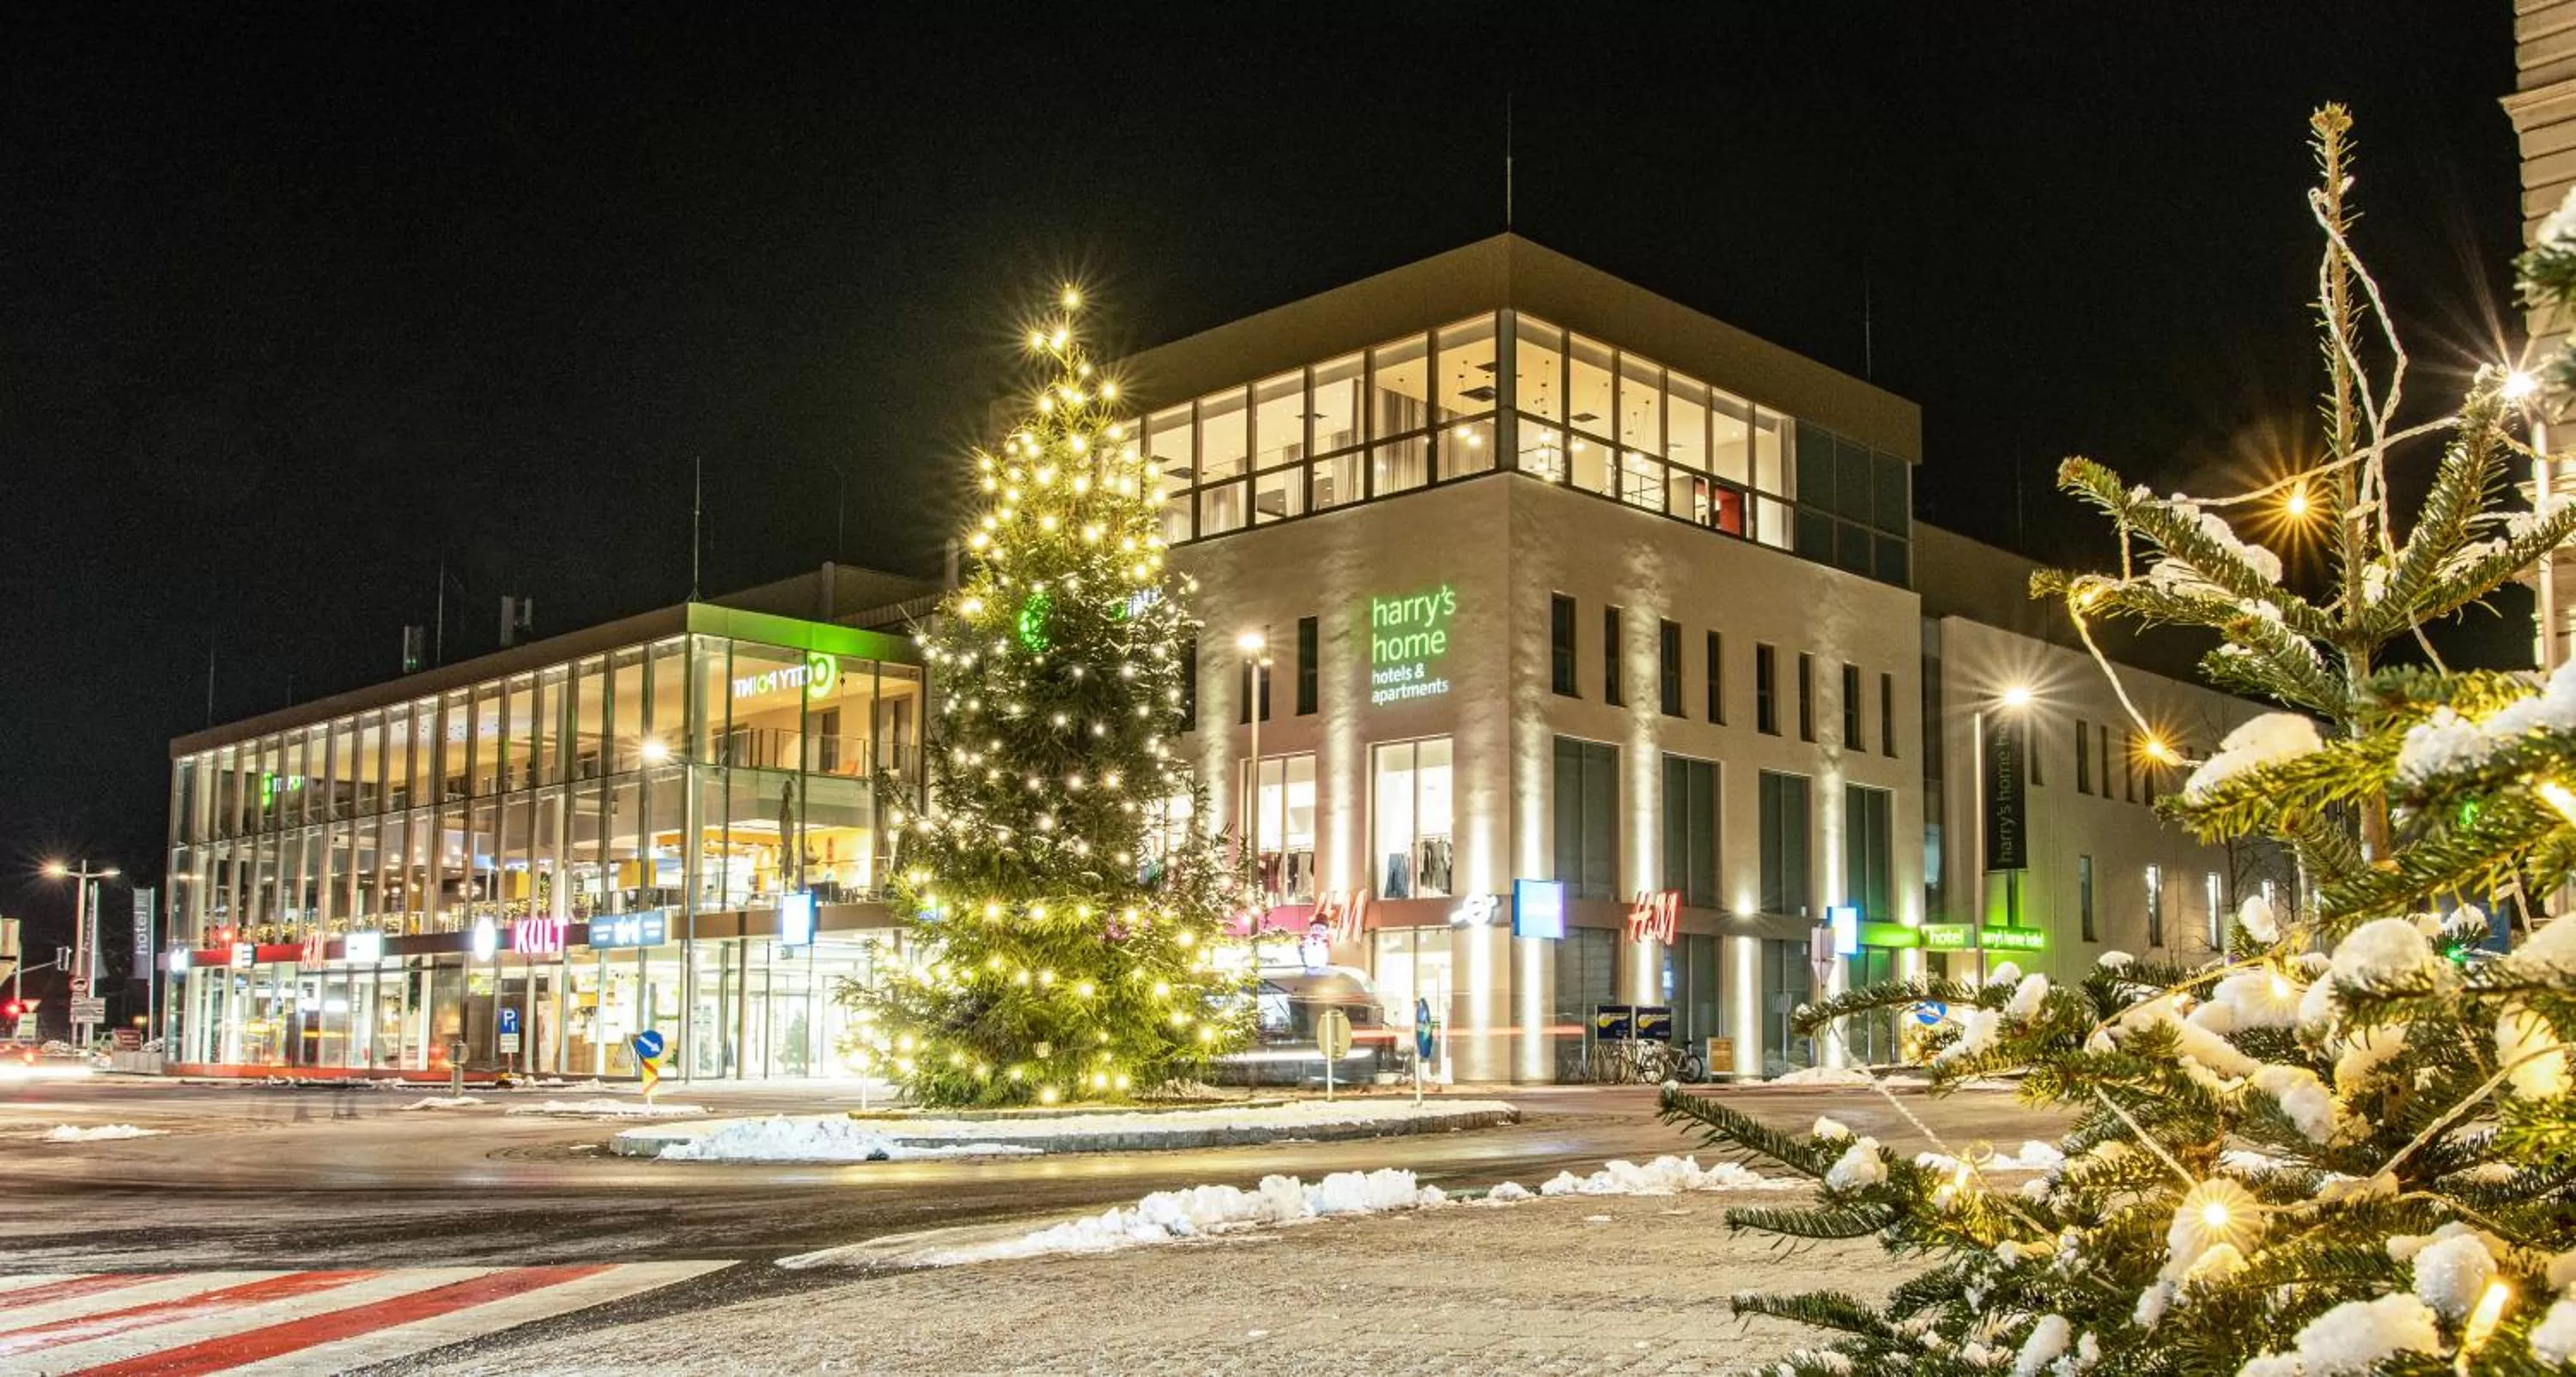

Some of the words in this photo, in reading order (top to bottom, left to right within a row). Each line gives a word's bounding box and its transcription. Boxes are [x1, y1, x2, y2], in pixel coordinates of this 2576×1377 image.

[1374, 584, 1456, 628] harry's
[1373, 629, 1446, 664] home
[1372, 664, 1413, 684] hotels
[1413, 662, 1425, 678] &
[1371, 677, 1449, 707] apartments
[134, 911, 148, 955] hotel
[515, 916, 569, 955] KULT
